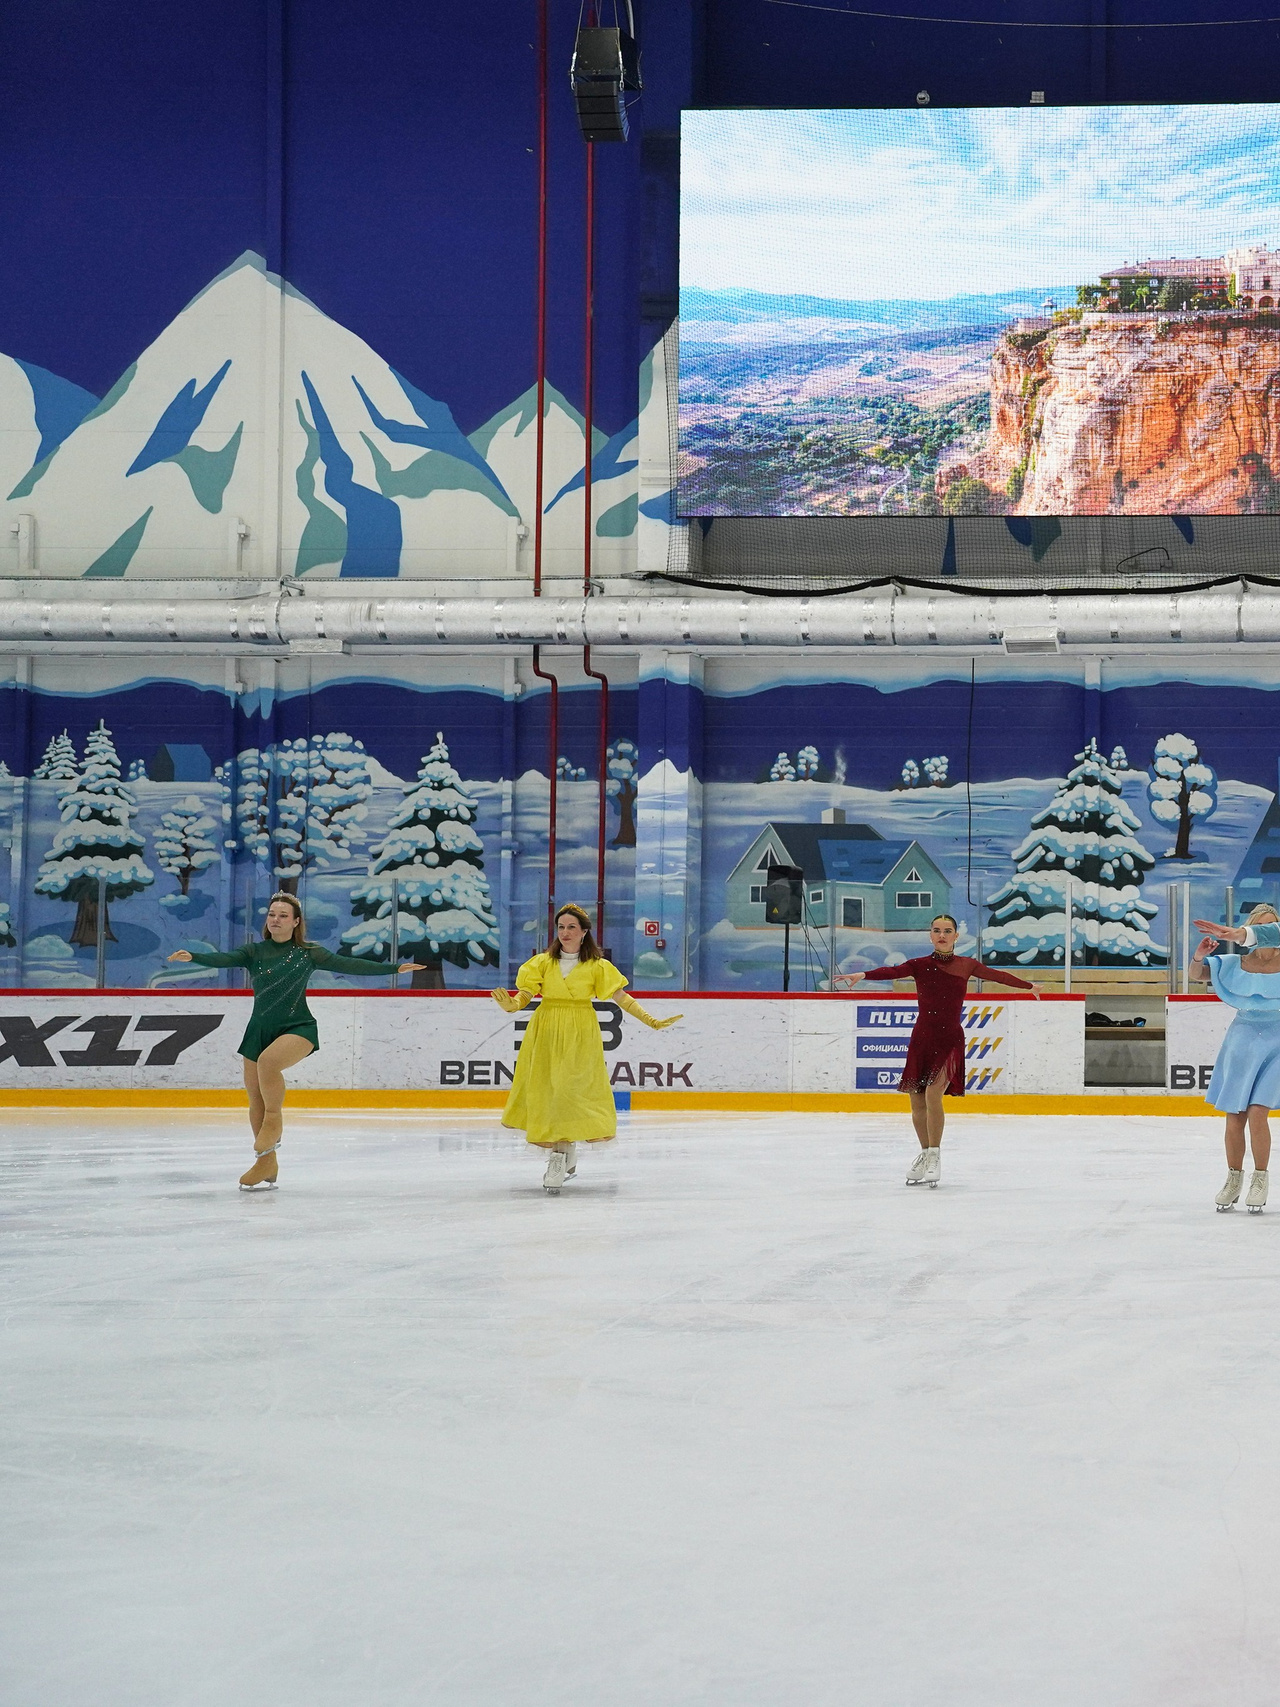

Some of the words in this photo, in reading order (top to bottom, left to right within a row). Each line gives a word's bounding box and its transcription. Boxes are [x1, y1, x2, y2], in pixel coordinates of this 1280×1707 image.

[869, 1011, 892, 1026] ГЦ
[894, 1011, 920, 1024] ТЕХ
[862, 1044, 909, 1053] ОФИЦИАЛЬ
